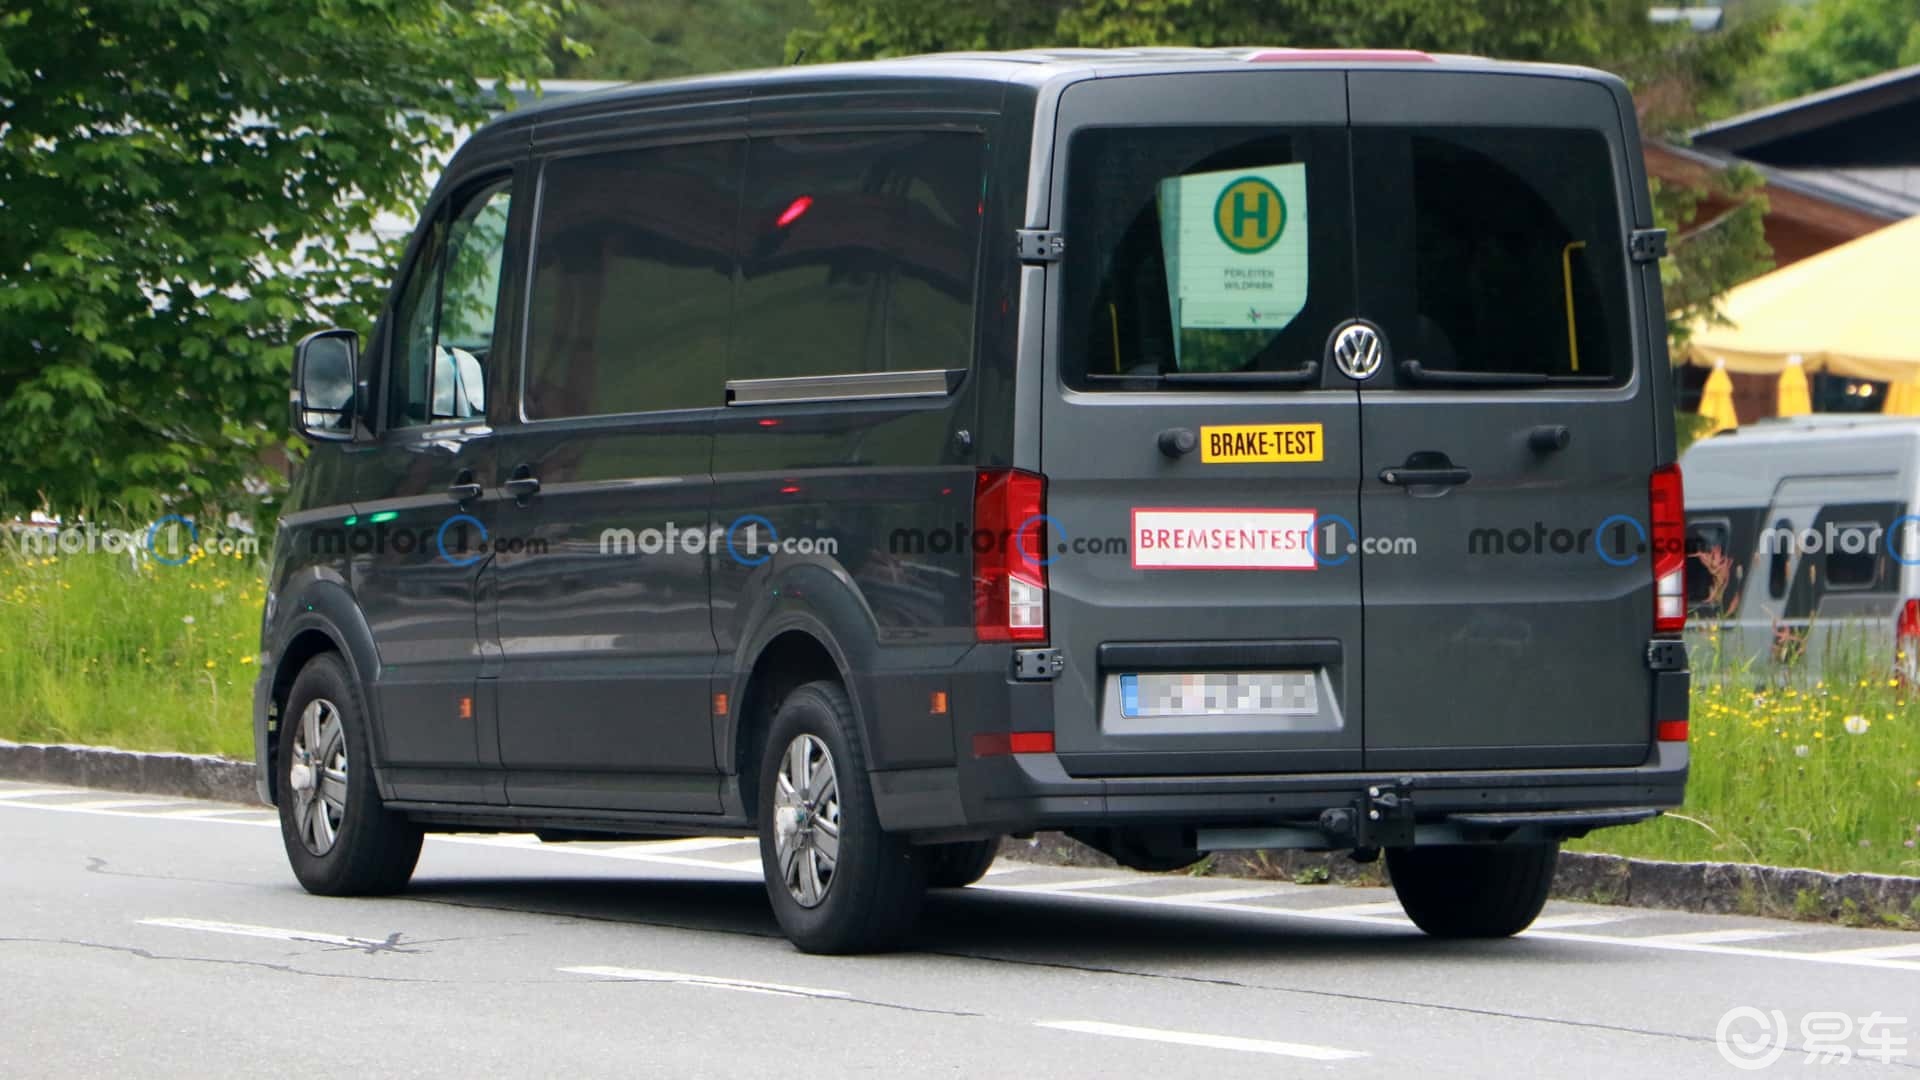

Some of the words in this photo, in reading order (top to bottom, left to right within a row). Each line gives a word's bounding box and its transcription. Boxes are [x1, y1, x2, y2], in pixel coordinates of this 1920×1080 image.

[1233, 191, 1269, 239] H
[1210, 430, 1316, 457] BRAKE-TEST
[1140, 528, 1309, 550] BREMSENTEST
